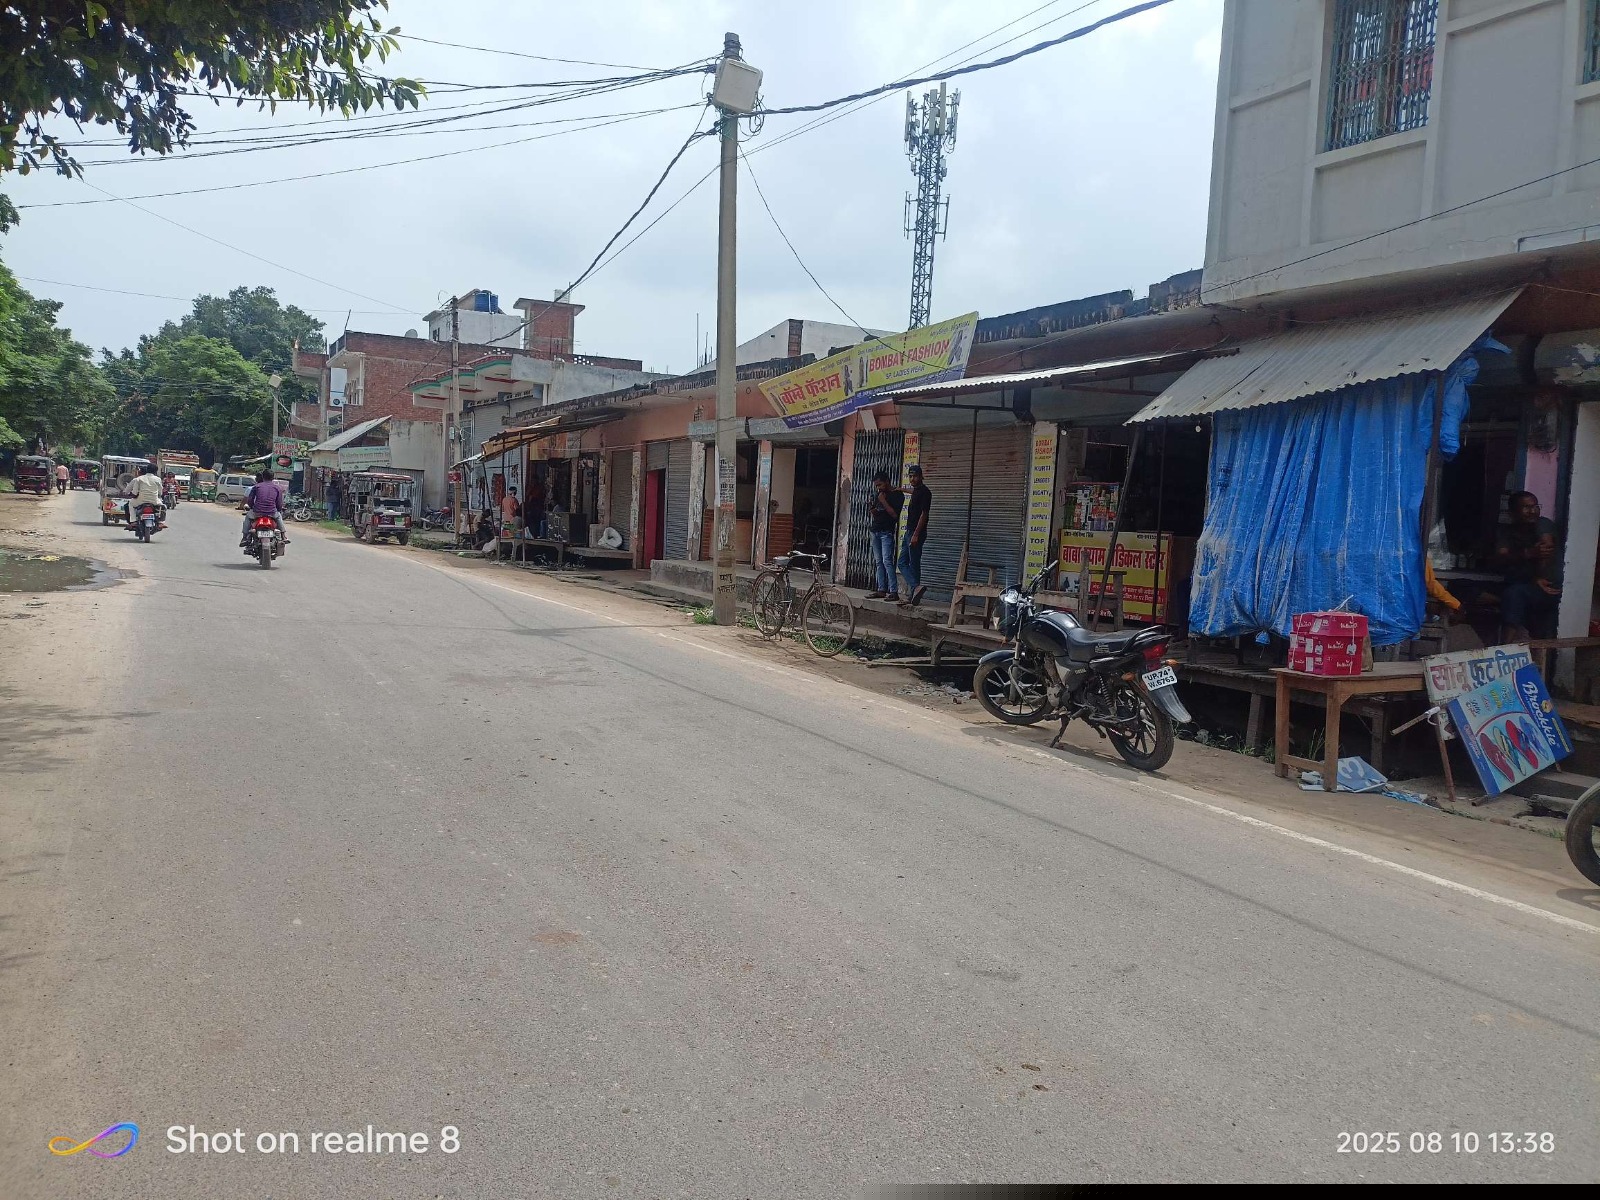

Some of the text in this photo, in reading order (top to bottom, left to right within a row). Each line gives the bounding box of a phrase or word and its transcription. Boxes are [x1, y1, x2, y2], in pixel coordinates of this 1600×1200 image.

[868, 350, 905, 373] BOMBAY
[906, 338, 952, 363] FASHION
[1062, 545, 1081, 564] बाबा
